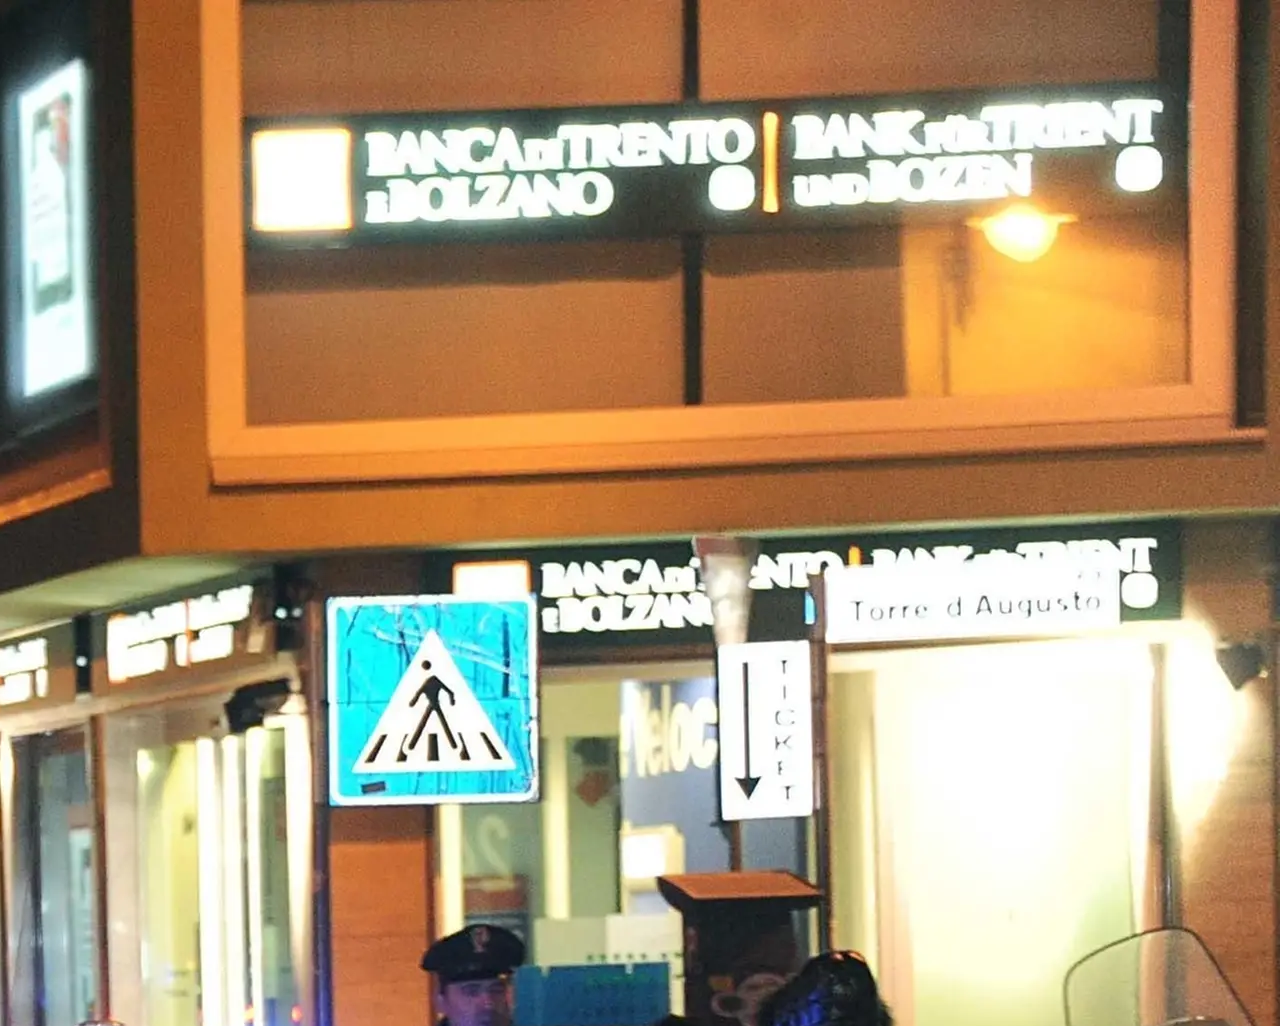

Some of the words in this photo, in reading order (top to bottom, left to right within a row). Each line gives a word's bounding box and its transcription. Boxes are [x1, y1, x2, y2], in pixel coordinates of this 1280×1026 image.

[365, 127, 524, 176] BANCA
[557, 118, 756, 168] TRENTO
[791, 110, 925, 160] BANK
[386, 171, 614, 223] BOLZANO
[866, 153, 1033, 203] BOZEN
[541, 558, 665, 597] BANCA
[852, 600, 929, 622] Torre
